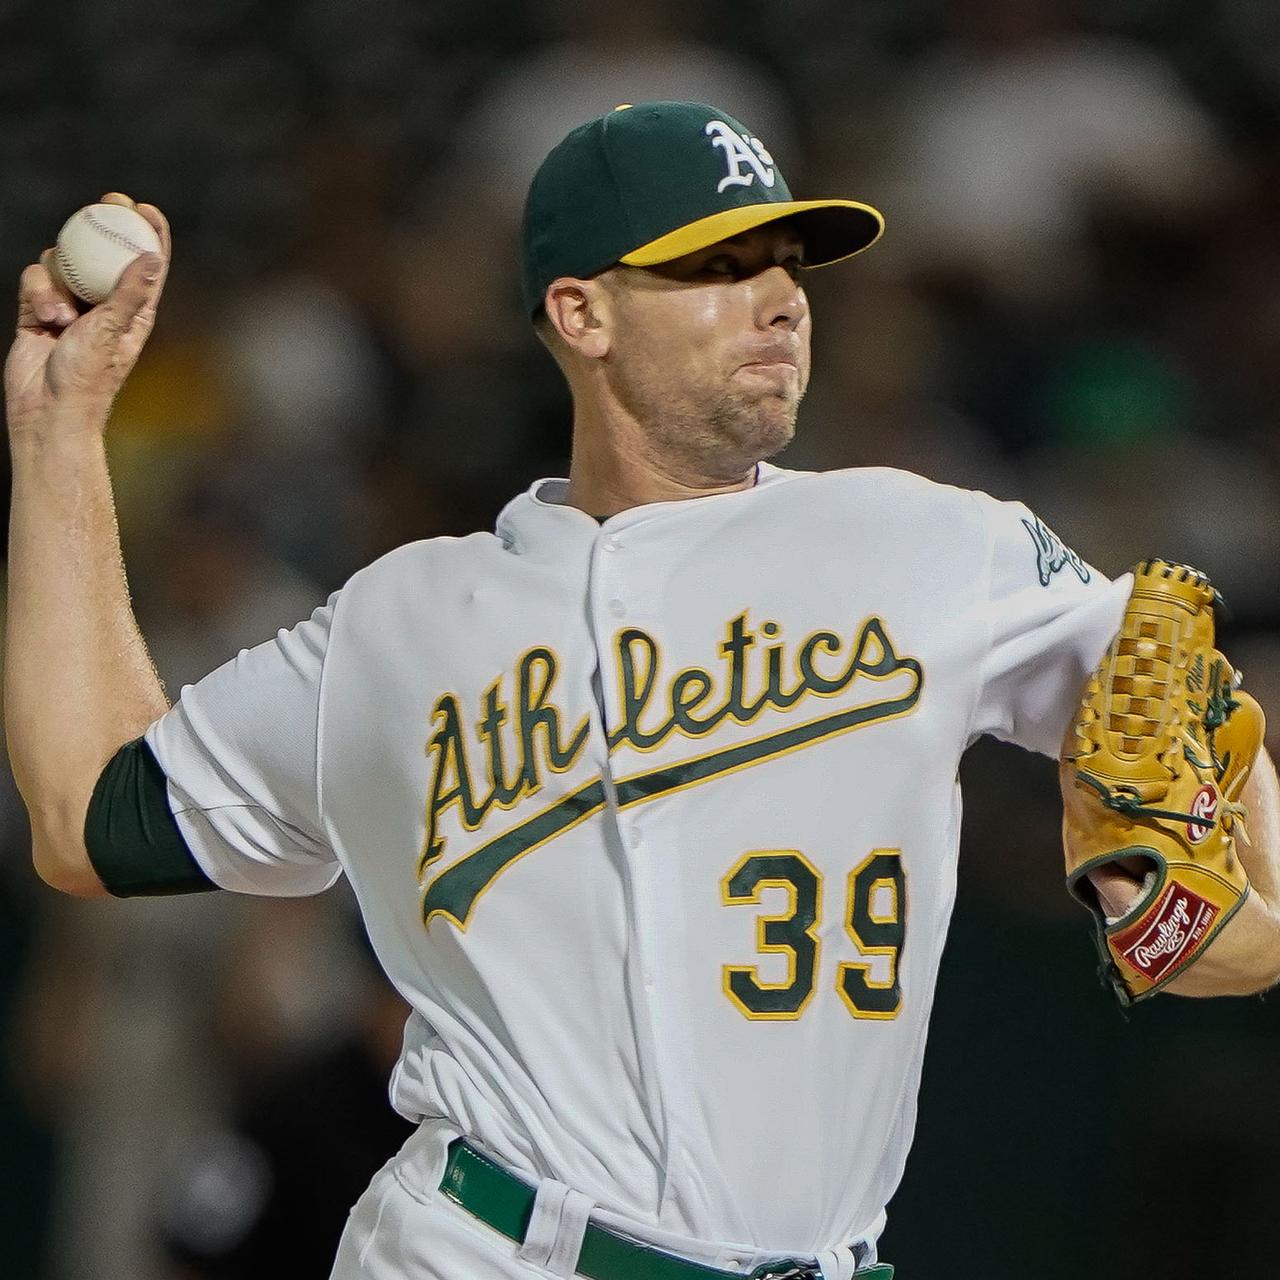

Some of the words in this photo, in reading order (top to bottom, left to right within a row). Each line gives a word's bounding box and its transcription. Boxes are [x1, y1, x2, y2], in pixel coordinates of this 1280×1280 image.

[417, 607, 924, 885] Athletics
[719, 848, 908, 1021] 39
[1134, 896, 1191, 968] Rawlings
